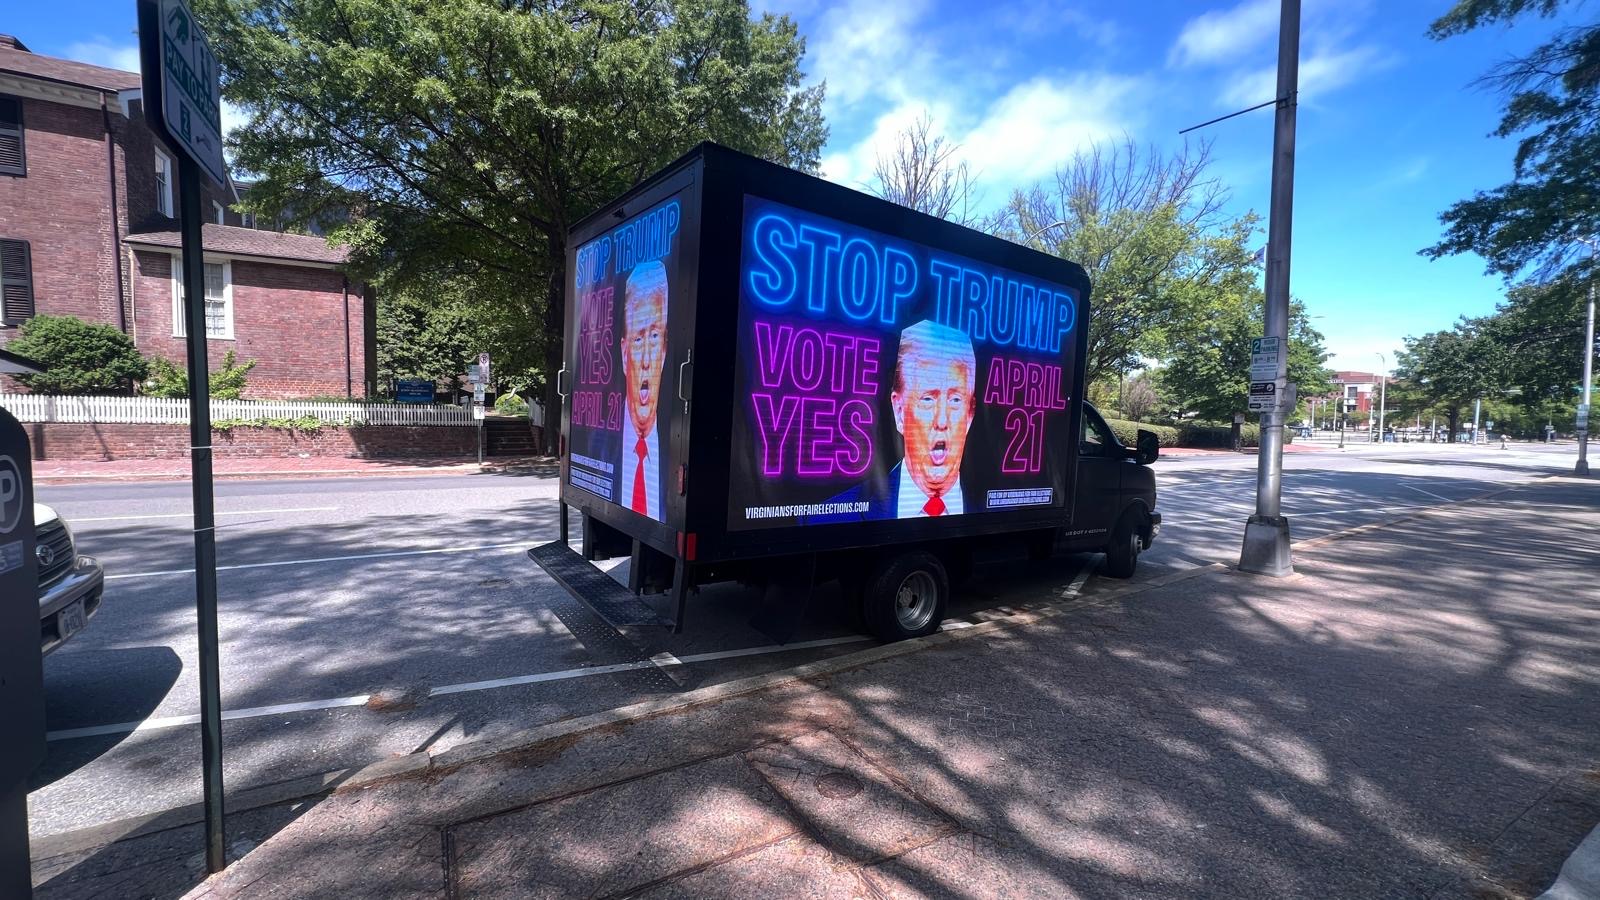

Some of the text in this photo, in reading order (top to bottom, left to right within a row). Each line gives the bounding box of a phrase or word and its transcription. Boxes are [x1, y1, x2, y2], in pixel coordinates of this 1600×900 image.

[166, 45, 184, 81] PAY
[186, 68, 198, 100] TO
[575, 202, 680, 288] STOP TRUMP
[582, 286, 614, 332] VOTE
[750, 215, 1075, 353] STOP TRUMP
[580, 327, 614, 385] YES
[755, 322, 880, 395] VOTE
[1253, 340, 1260, 352] 2
[571, 391, 622, 432] APRIL 21
[984, 357, 1066, 410] APRIL
[752, 393, 874, 475] YES
[1002, 409, 1044, 473] 21
[745, 501, 870, 519] VIRGINIANSFORFAIRELECTIONS.COM
